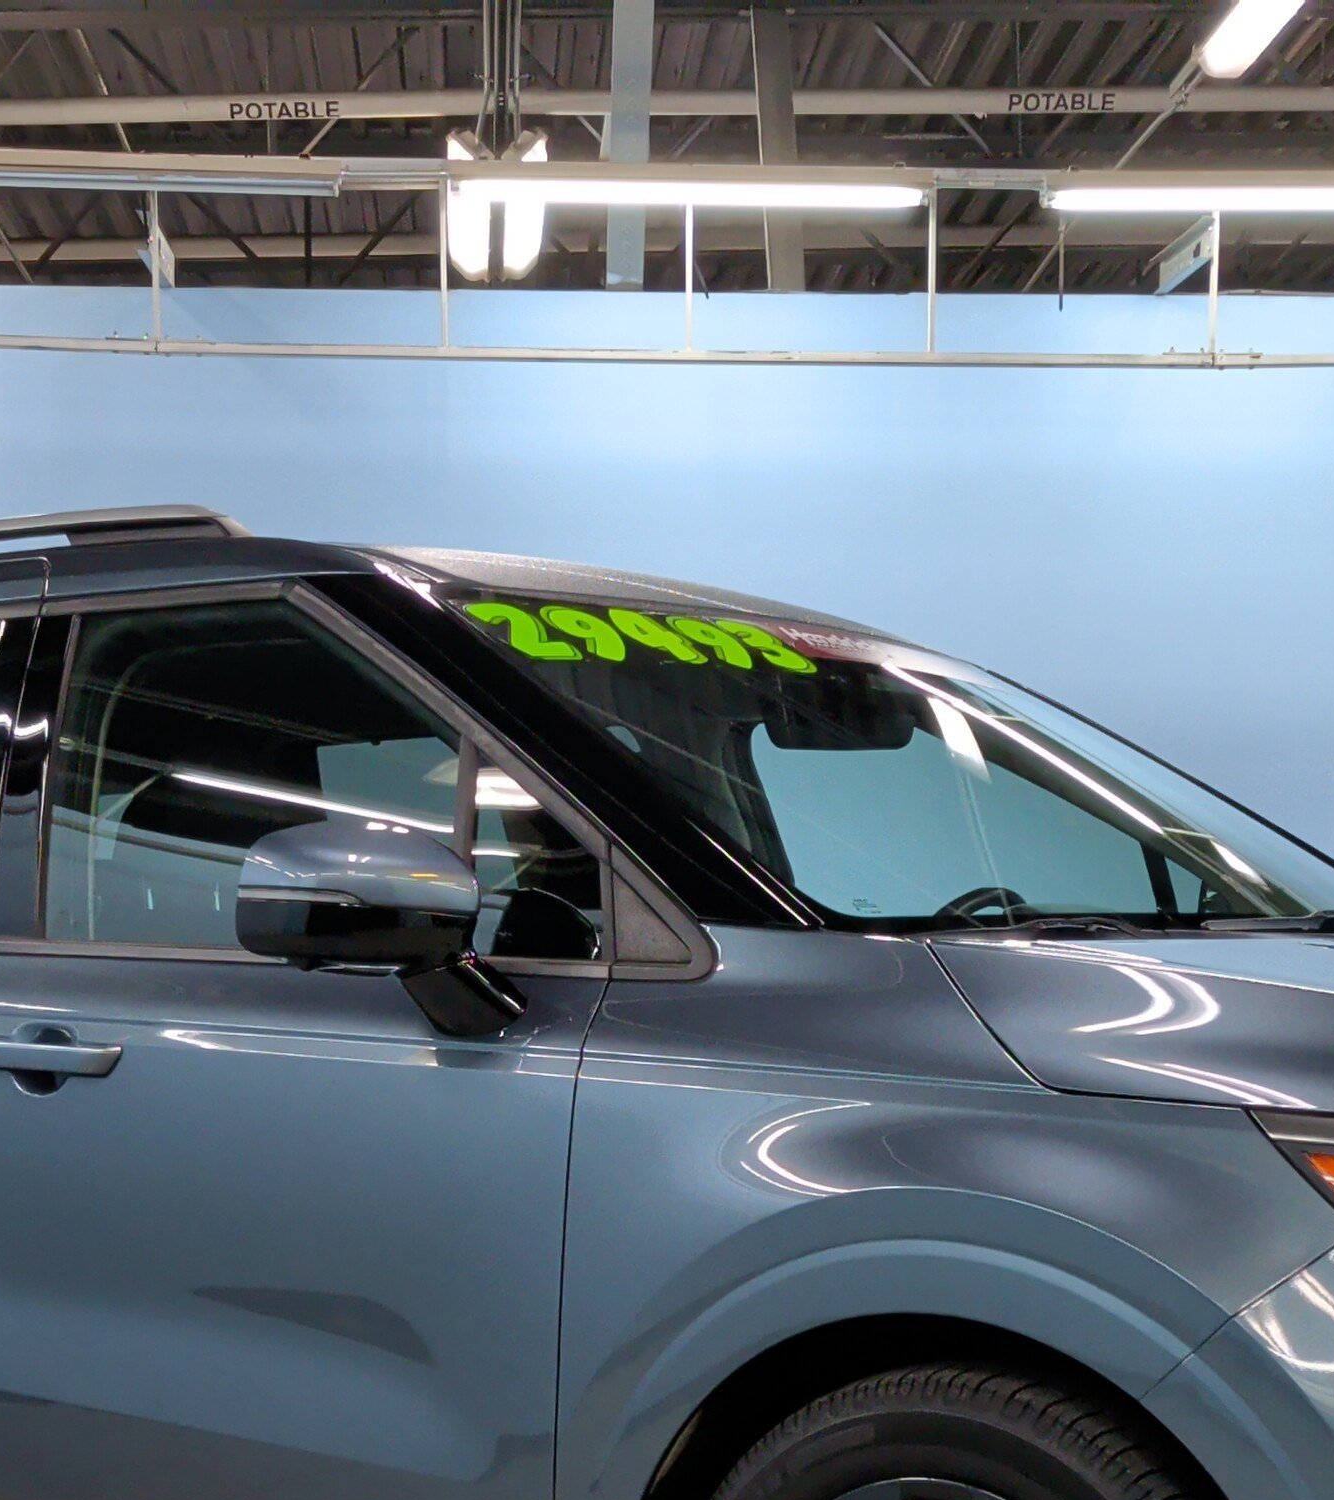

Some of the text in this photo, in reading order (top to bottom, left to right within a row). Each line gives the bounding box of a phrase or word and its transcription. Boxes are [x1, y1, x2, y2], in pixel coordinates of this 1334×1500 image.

[229, 101, 340, 119] POTABLE
[1008, 93, 1116, 112] POTABLE
[463, 602, 818, 675] 29493
